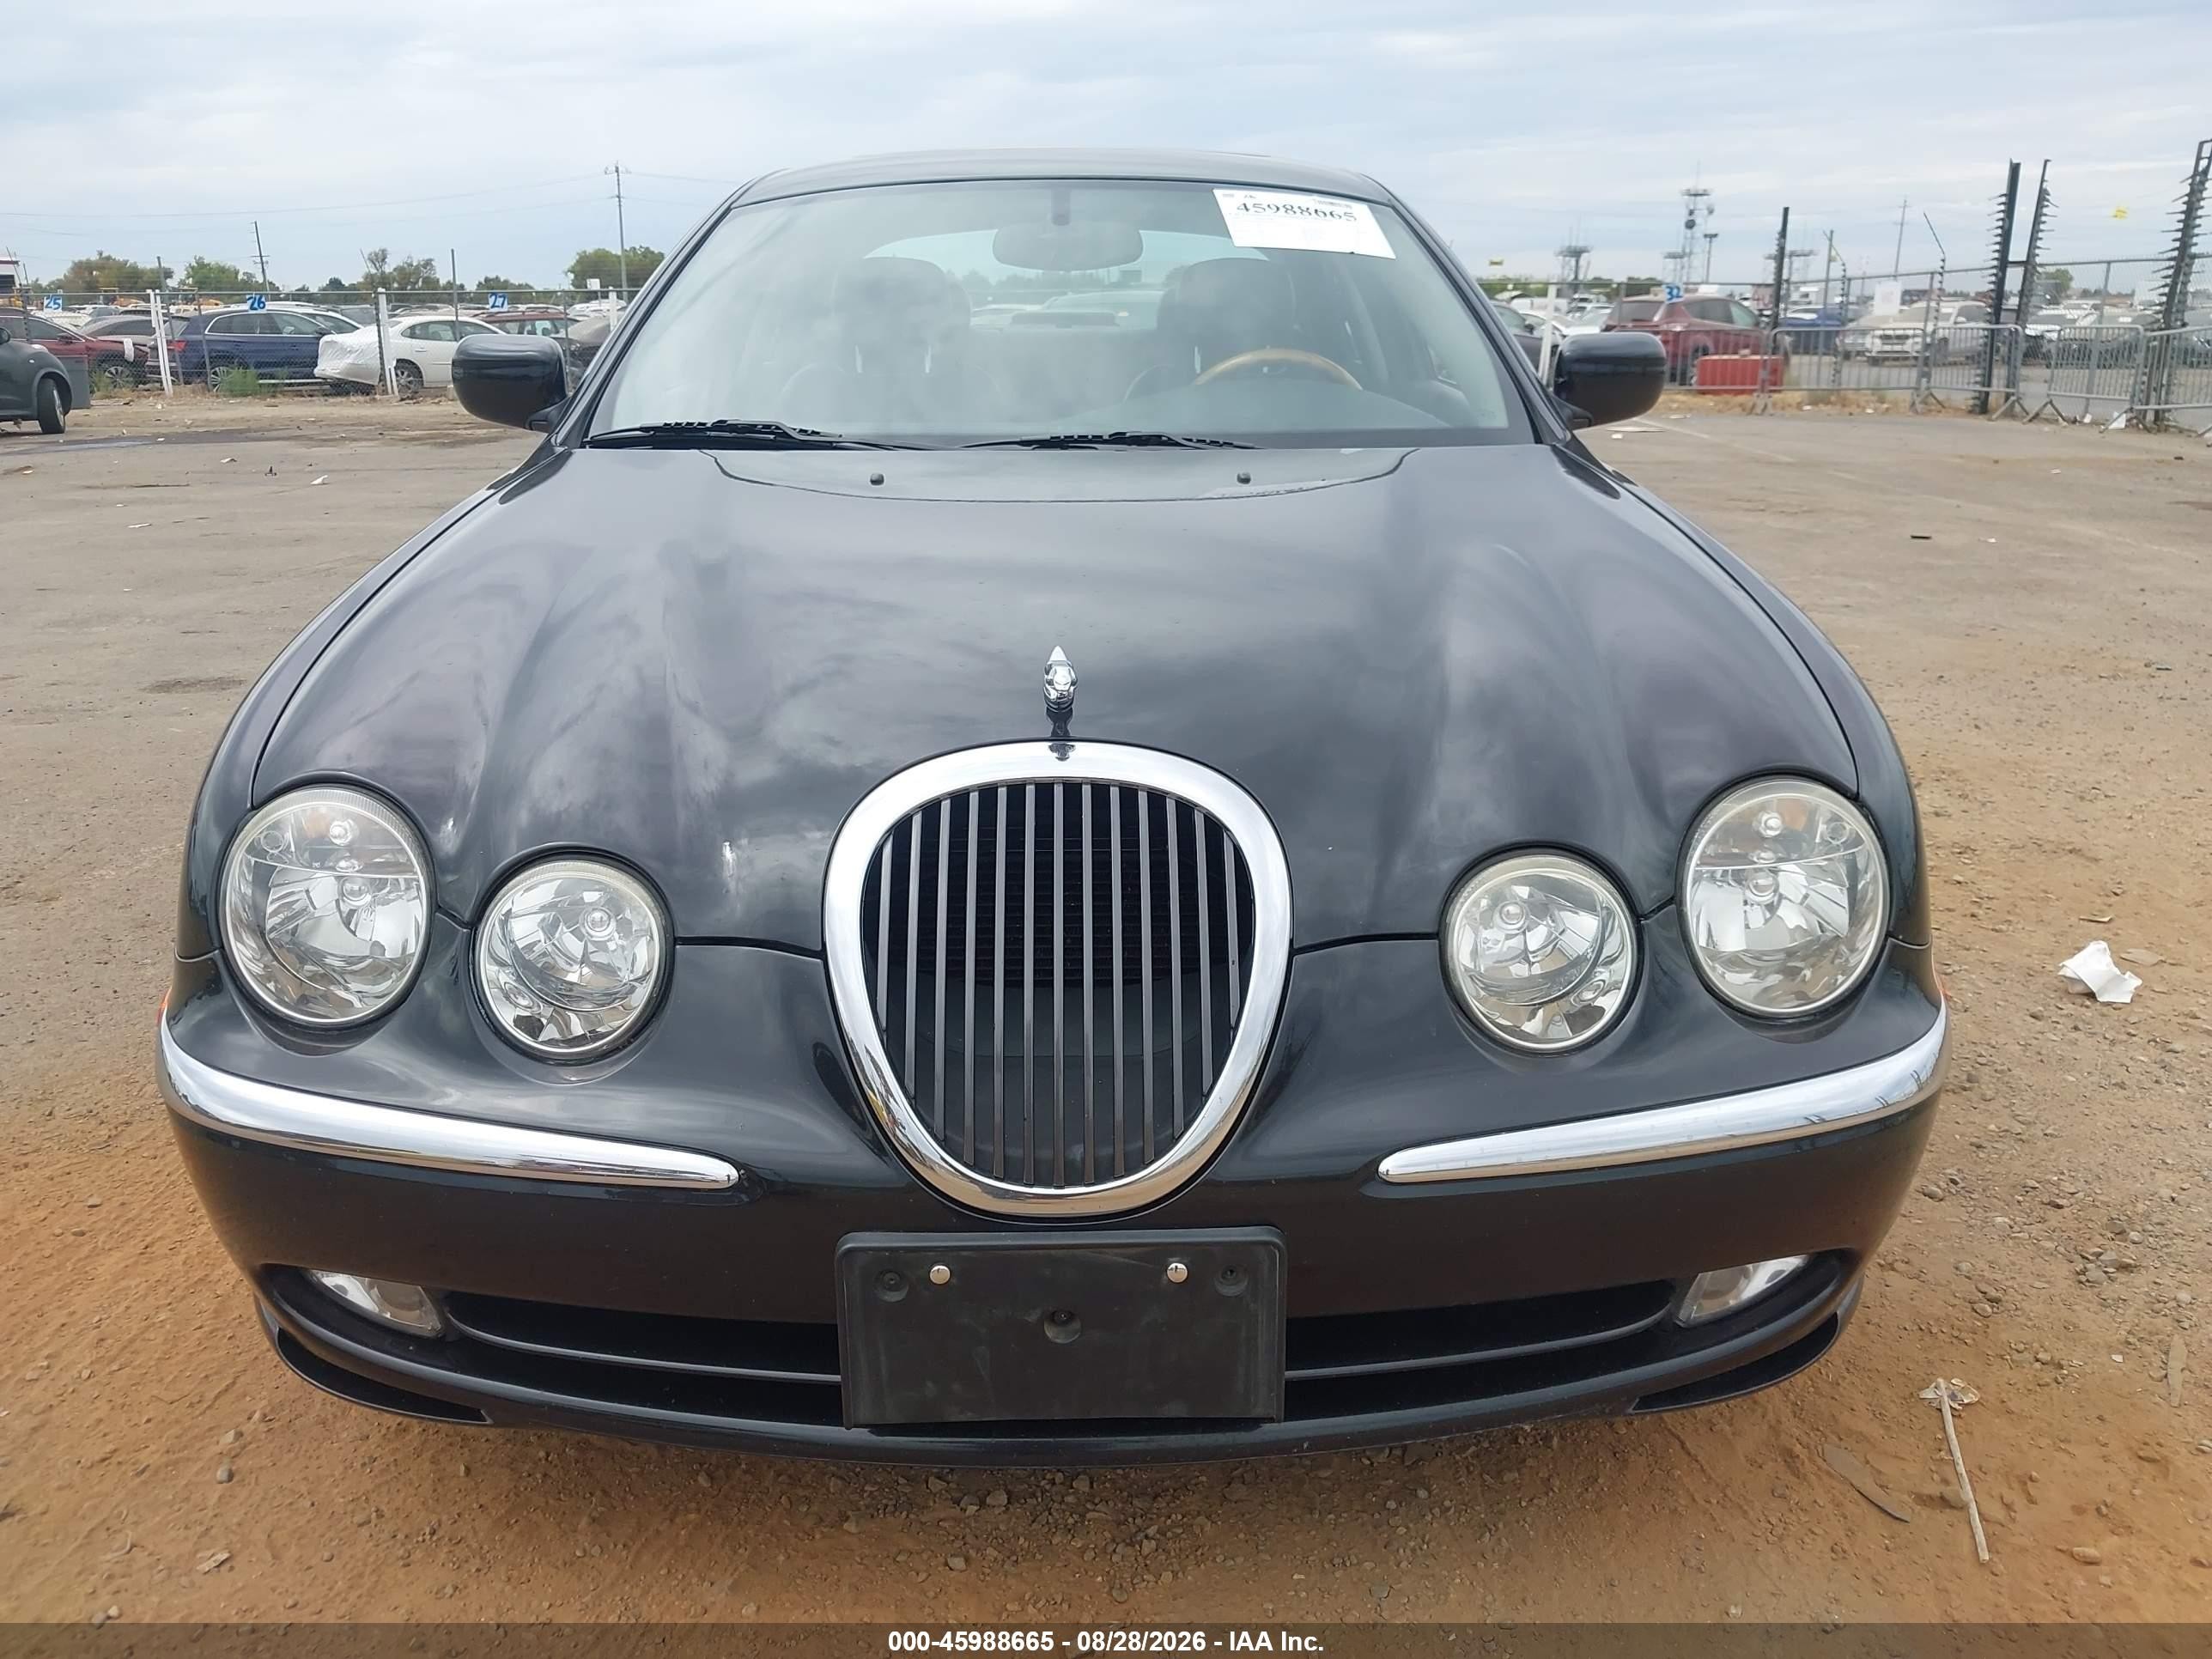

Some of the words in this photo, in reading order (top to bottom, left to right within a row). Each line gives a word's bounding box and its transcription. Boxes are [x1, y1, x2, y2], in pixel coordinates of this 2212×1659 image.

[1237, 203, 1358, 222] 45988665
[489, 293, 507, 309] 27
[1665, 285, 1683, 301] 32
[45, 295, 62, 310] 25
[247, 295, 266, 311] 26
